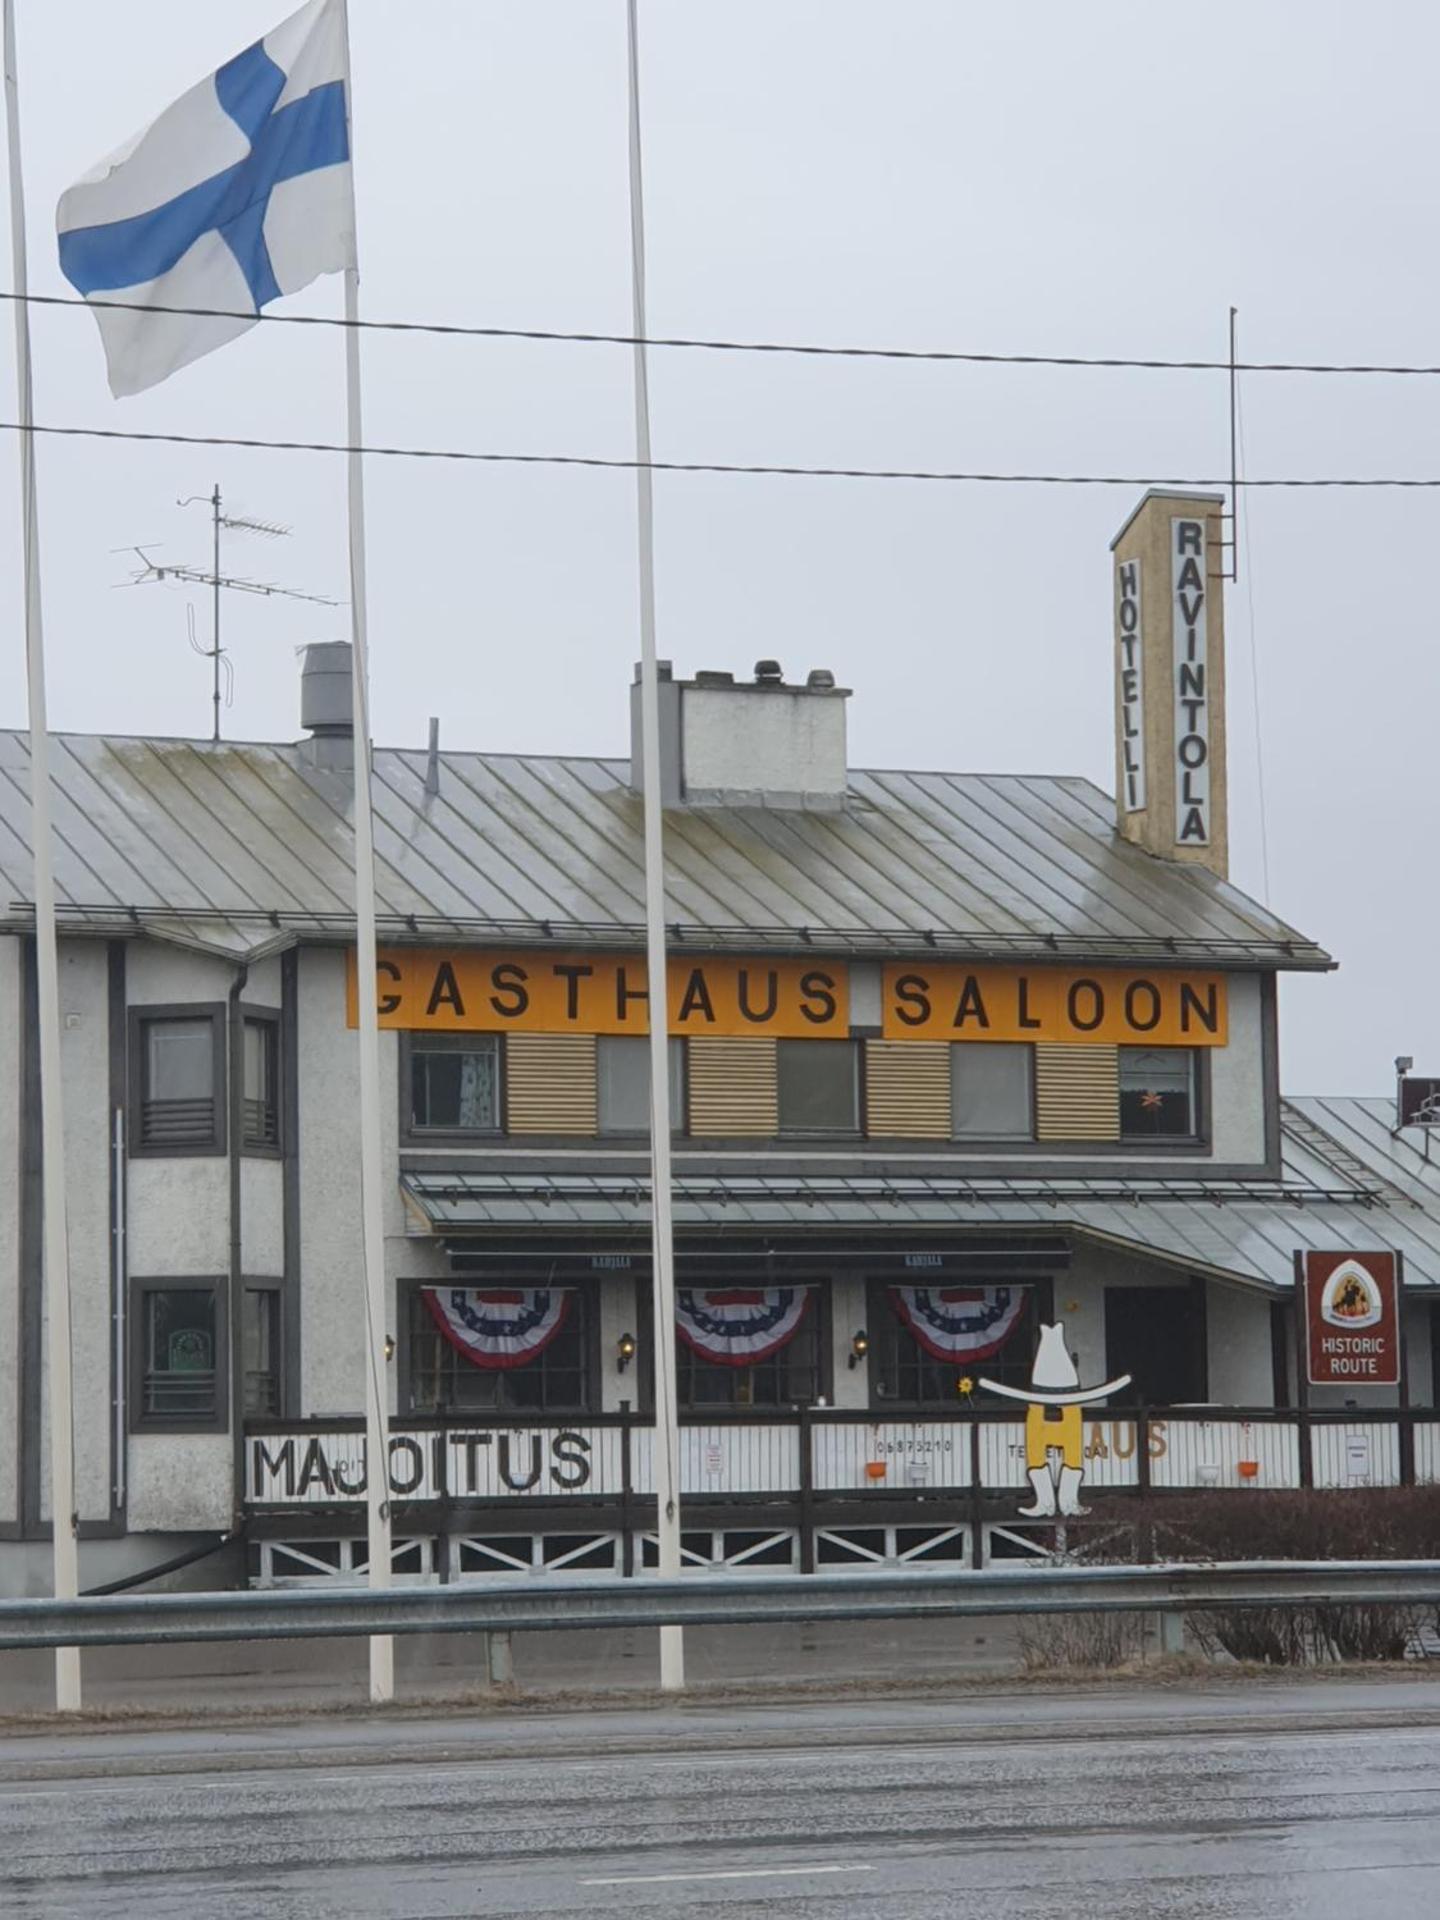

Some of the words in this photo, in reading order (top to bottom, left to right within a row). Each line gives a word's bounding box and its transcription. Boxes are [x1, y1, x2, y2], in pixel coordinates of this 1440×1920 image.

[1118, 563, 1139, 807] HOTELLI
[1176, 521, 1207, 841] RAVINTOLA
[376, 960, 837, 1024] GASTHAUS
[894, 974, 1218, 1034] SALOON
[1321, 1337, 1386, 1354] HISTORIC
[1330, 1357, 1379, 1374] ROUTE
[253, 1430, 592, 1497] MAJOITUS
